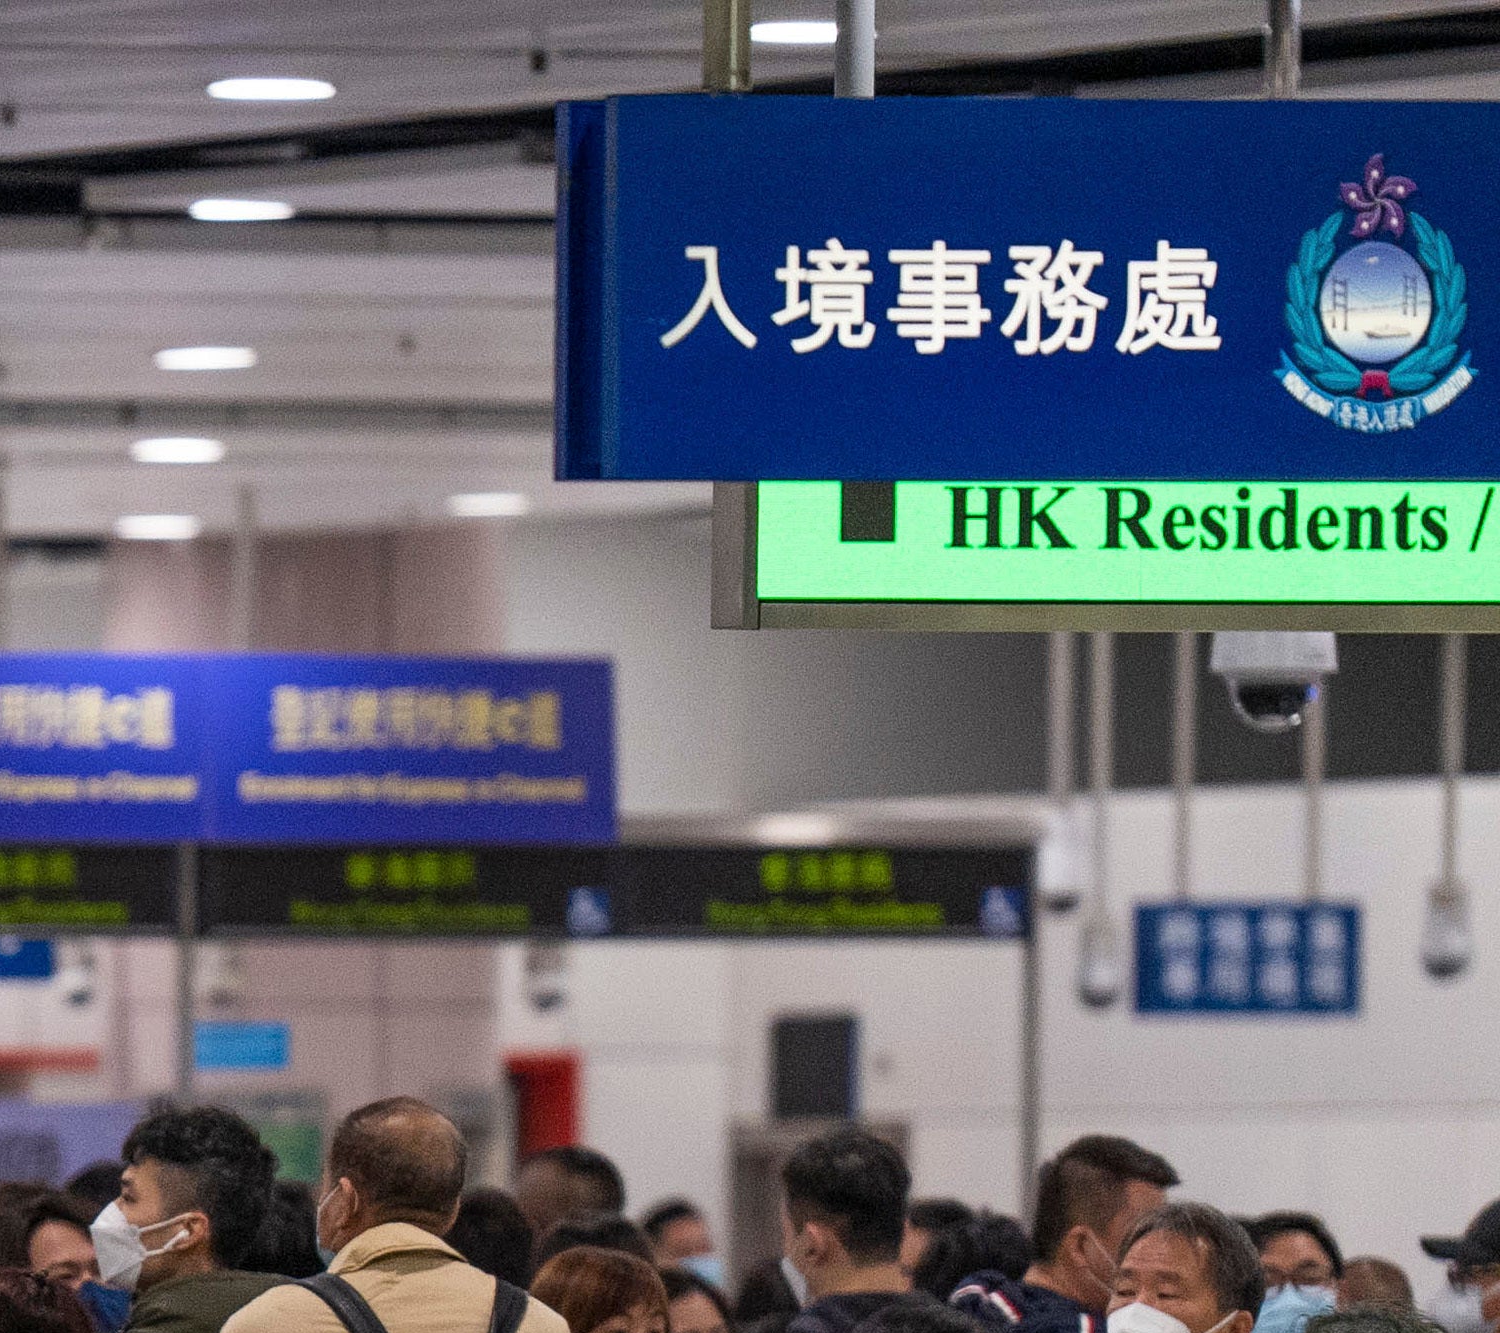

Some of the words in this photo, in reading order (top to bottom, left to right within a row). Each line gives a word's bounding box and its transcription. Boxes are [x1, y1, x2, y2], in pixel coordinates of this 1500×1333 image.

[659, 237, 1222, 356] 入境事務處
[945, 486, 1078, 552] HK
[1101, 486, 1450, 553] Residents
